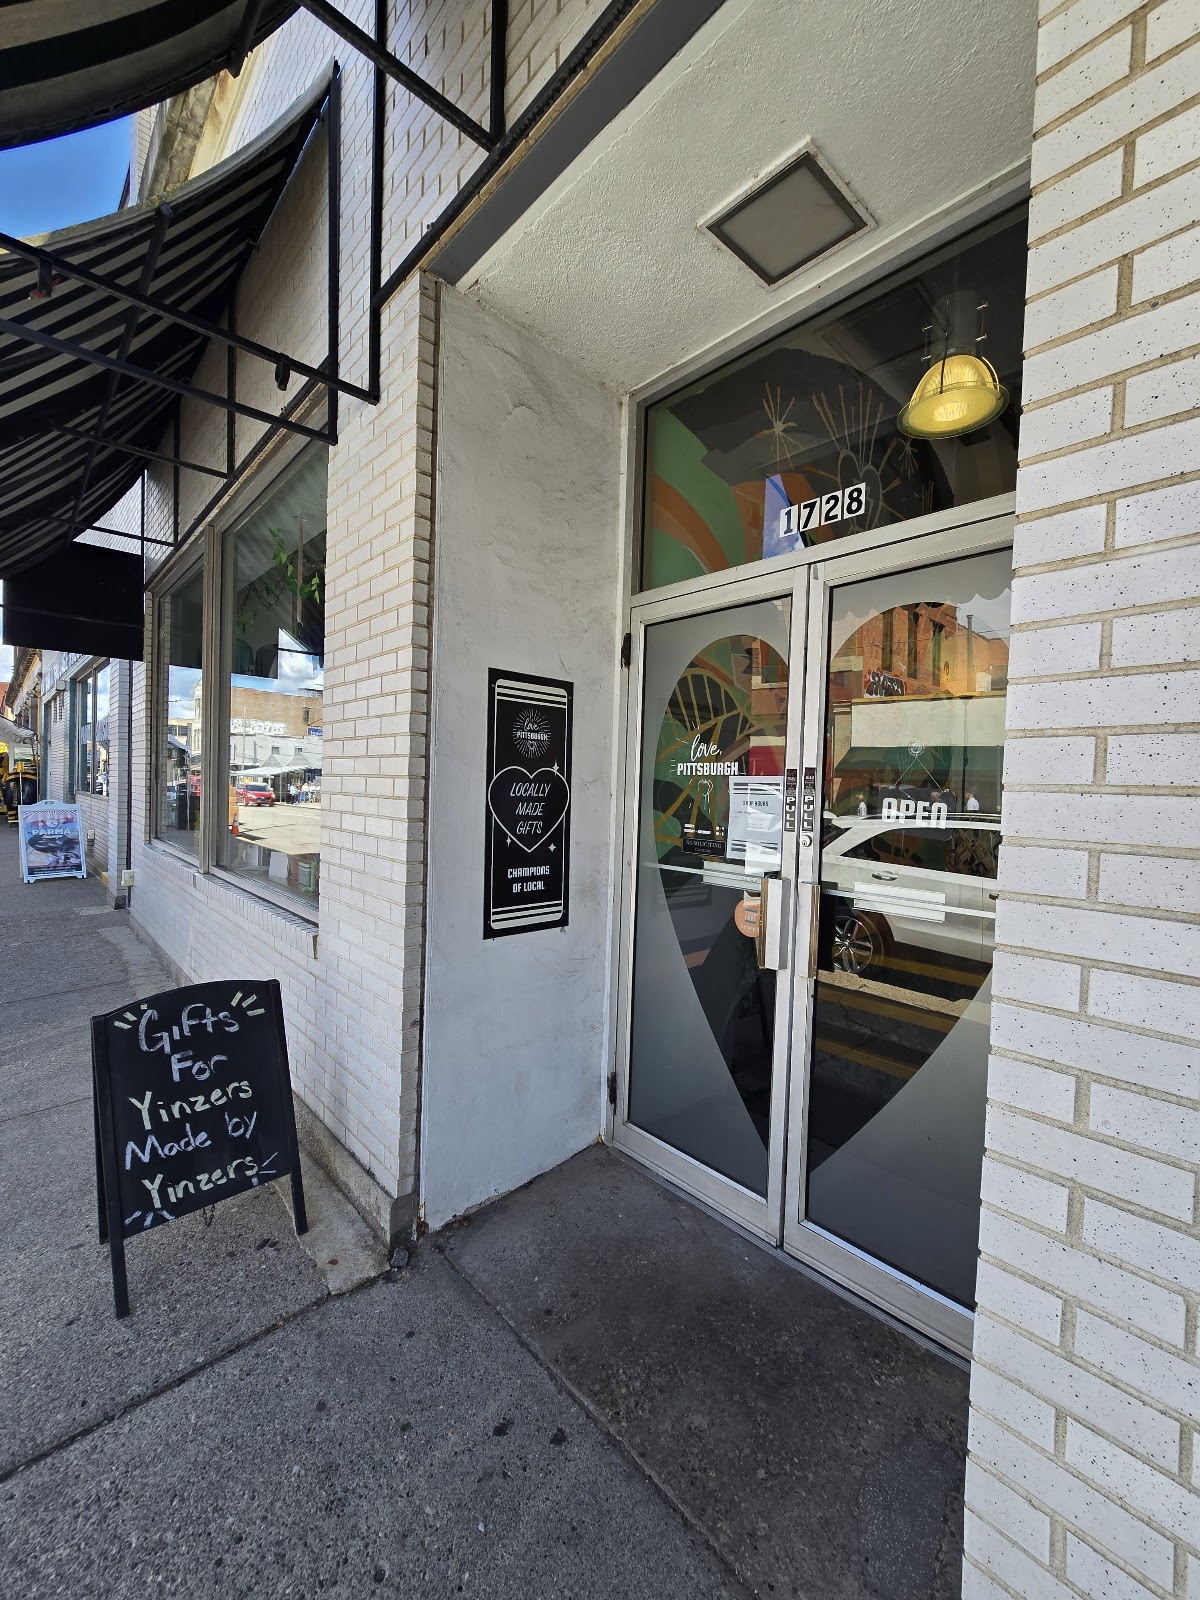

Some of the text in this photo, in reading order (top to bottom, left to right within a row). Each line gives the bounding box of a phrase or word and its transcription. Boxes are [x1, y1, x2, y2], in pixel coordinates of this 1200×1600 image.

[784, 487, 863, 535] 1728
[516, 731, 548, 741] PITTSBURGH
[677, 762, 739, 776] PITTSBURGH
[510, 782, 551, 797] LOCALLY
[515, 802, 546, 816] MADE
[785, 796, 796, 829] PULL
[803, 795, 814, 829] PULL
[882, 797, 949, 830] OPEN
[31, 828, 72, 836] PARMA
[516, 821, 543, 835] GIFTS
[693, 841, 722, 849] SOLICITING
[507, 865, 550, 879] CHAMPIONS
[512, 881, 545, 893] OF LOCAL
[170, 1050, 229, 1082] For
[127, 1080, 253, 1131] Yinzers
[125, 1111, 257, 1171] Made by
[141, 1156, 259, 1209] Yinzers
